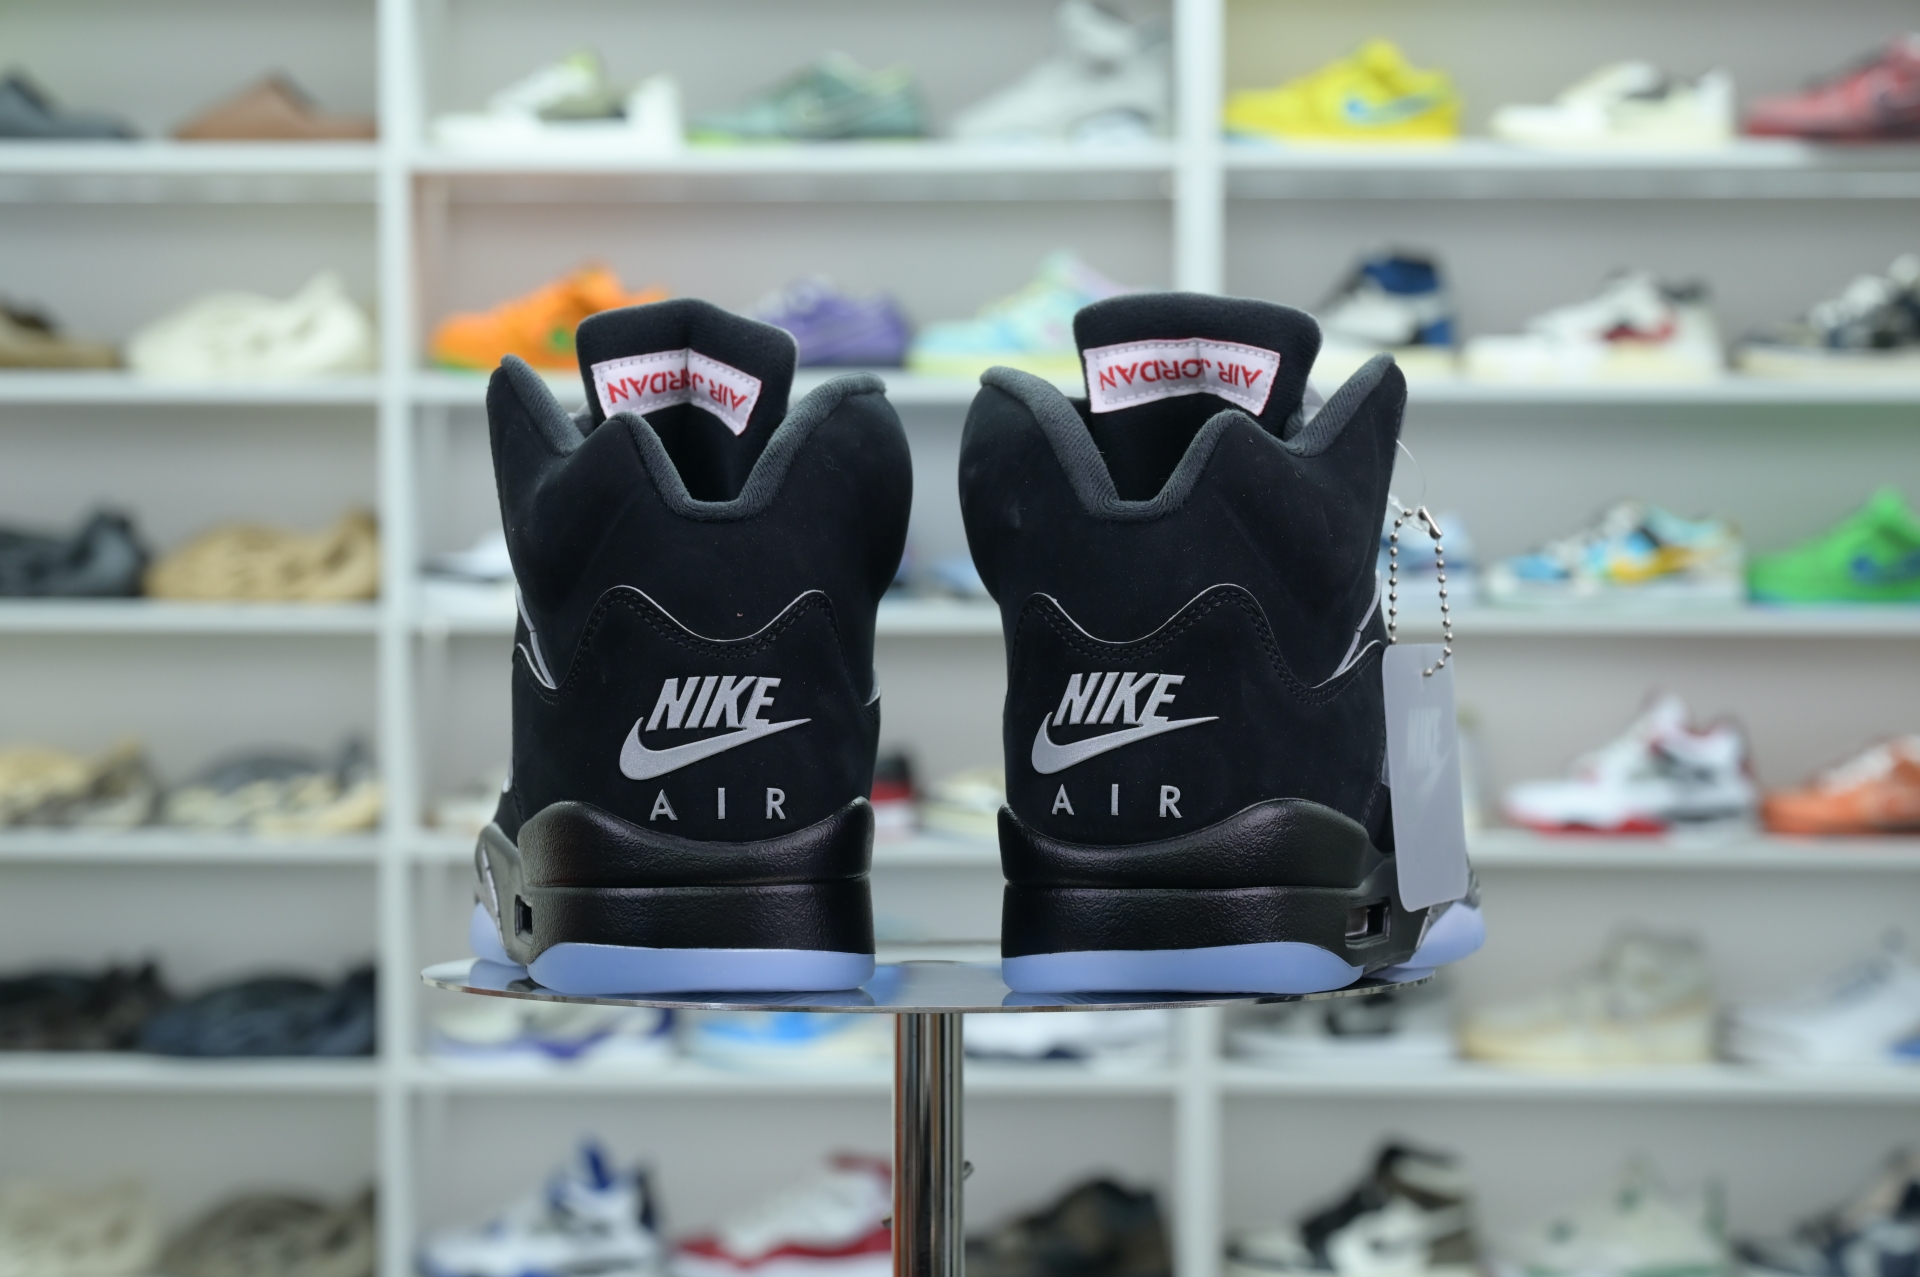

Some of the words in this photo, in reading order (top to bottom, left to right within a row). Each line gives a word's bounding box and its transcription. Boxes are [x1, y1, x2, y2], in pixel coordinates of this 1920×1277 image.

[607, 367, 704, 404] JRDAN
[1216, 360, 1263, 389] AIR
[709, 378, 748, 411] AIR
[645, 675, 781, 731] NIKE
[1052, 671, 1186, 727] NIKE
[649, 787, 786, 821] AIR
[1051, 783, 1183, 819] AIR
